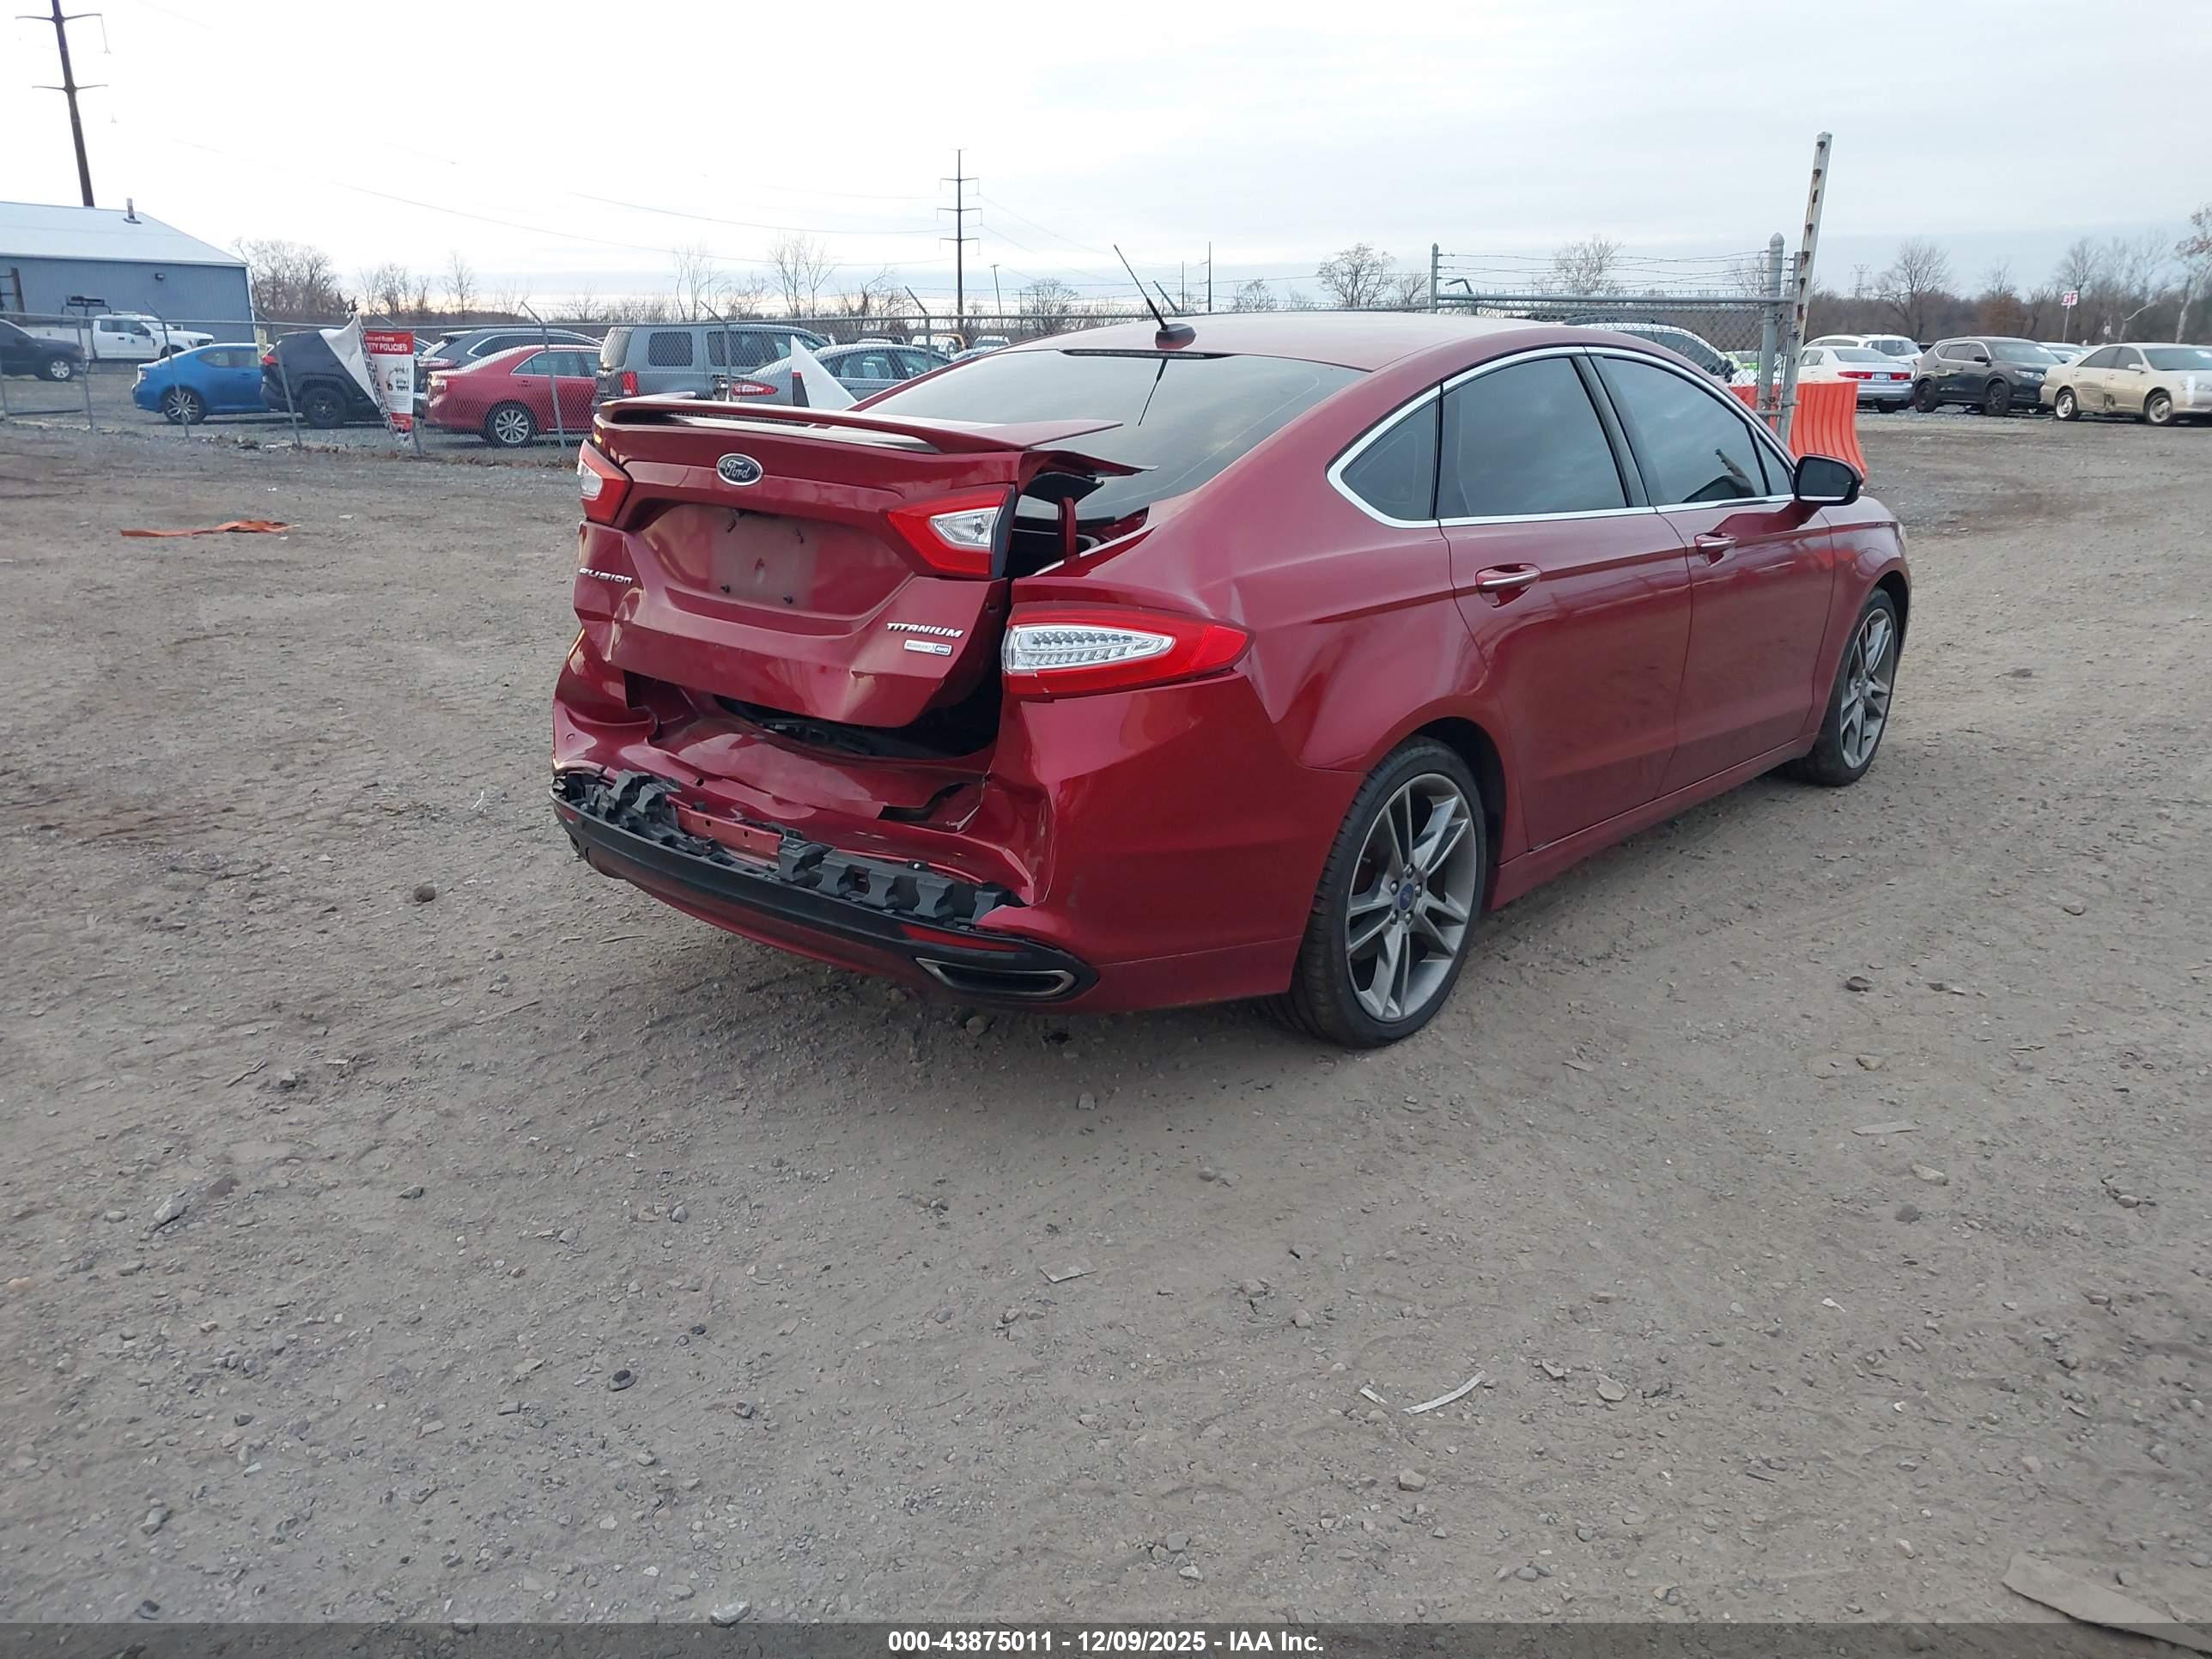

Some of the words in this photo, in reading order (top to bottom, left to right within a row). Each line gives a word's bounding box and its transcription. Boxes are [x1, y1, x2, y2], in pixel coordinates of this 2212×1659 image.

[380, 343, 408, 352] POLICIES
[725, 459, 750, 479] Ford
[887, 623, 963, 638] TITANIUM
